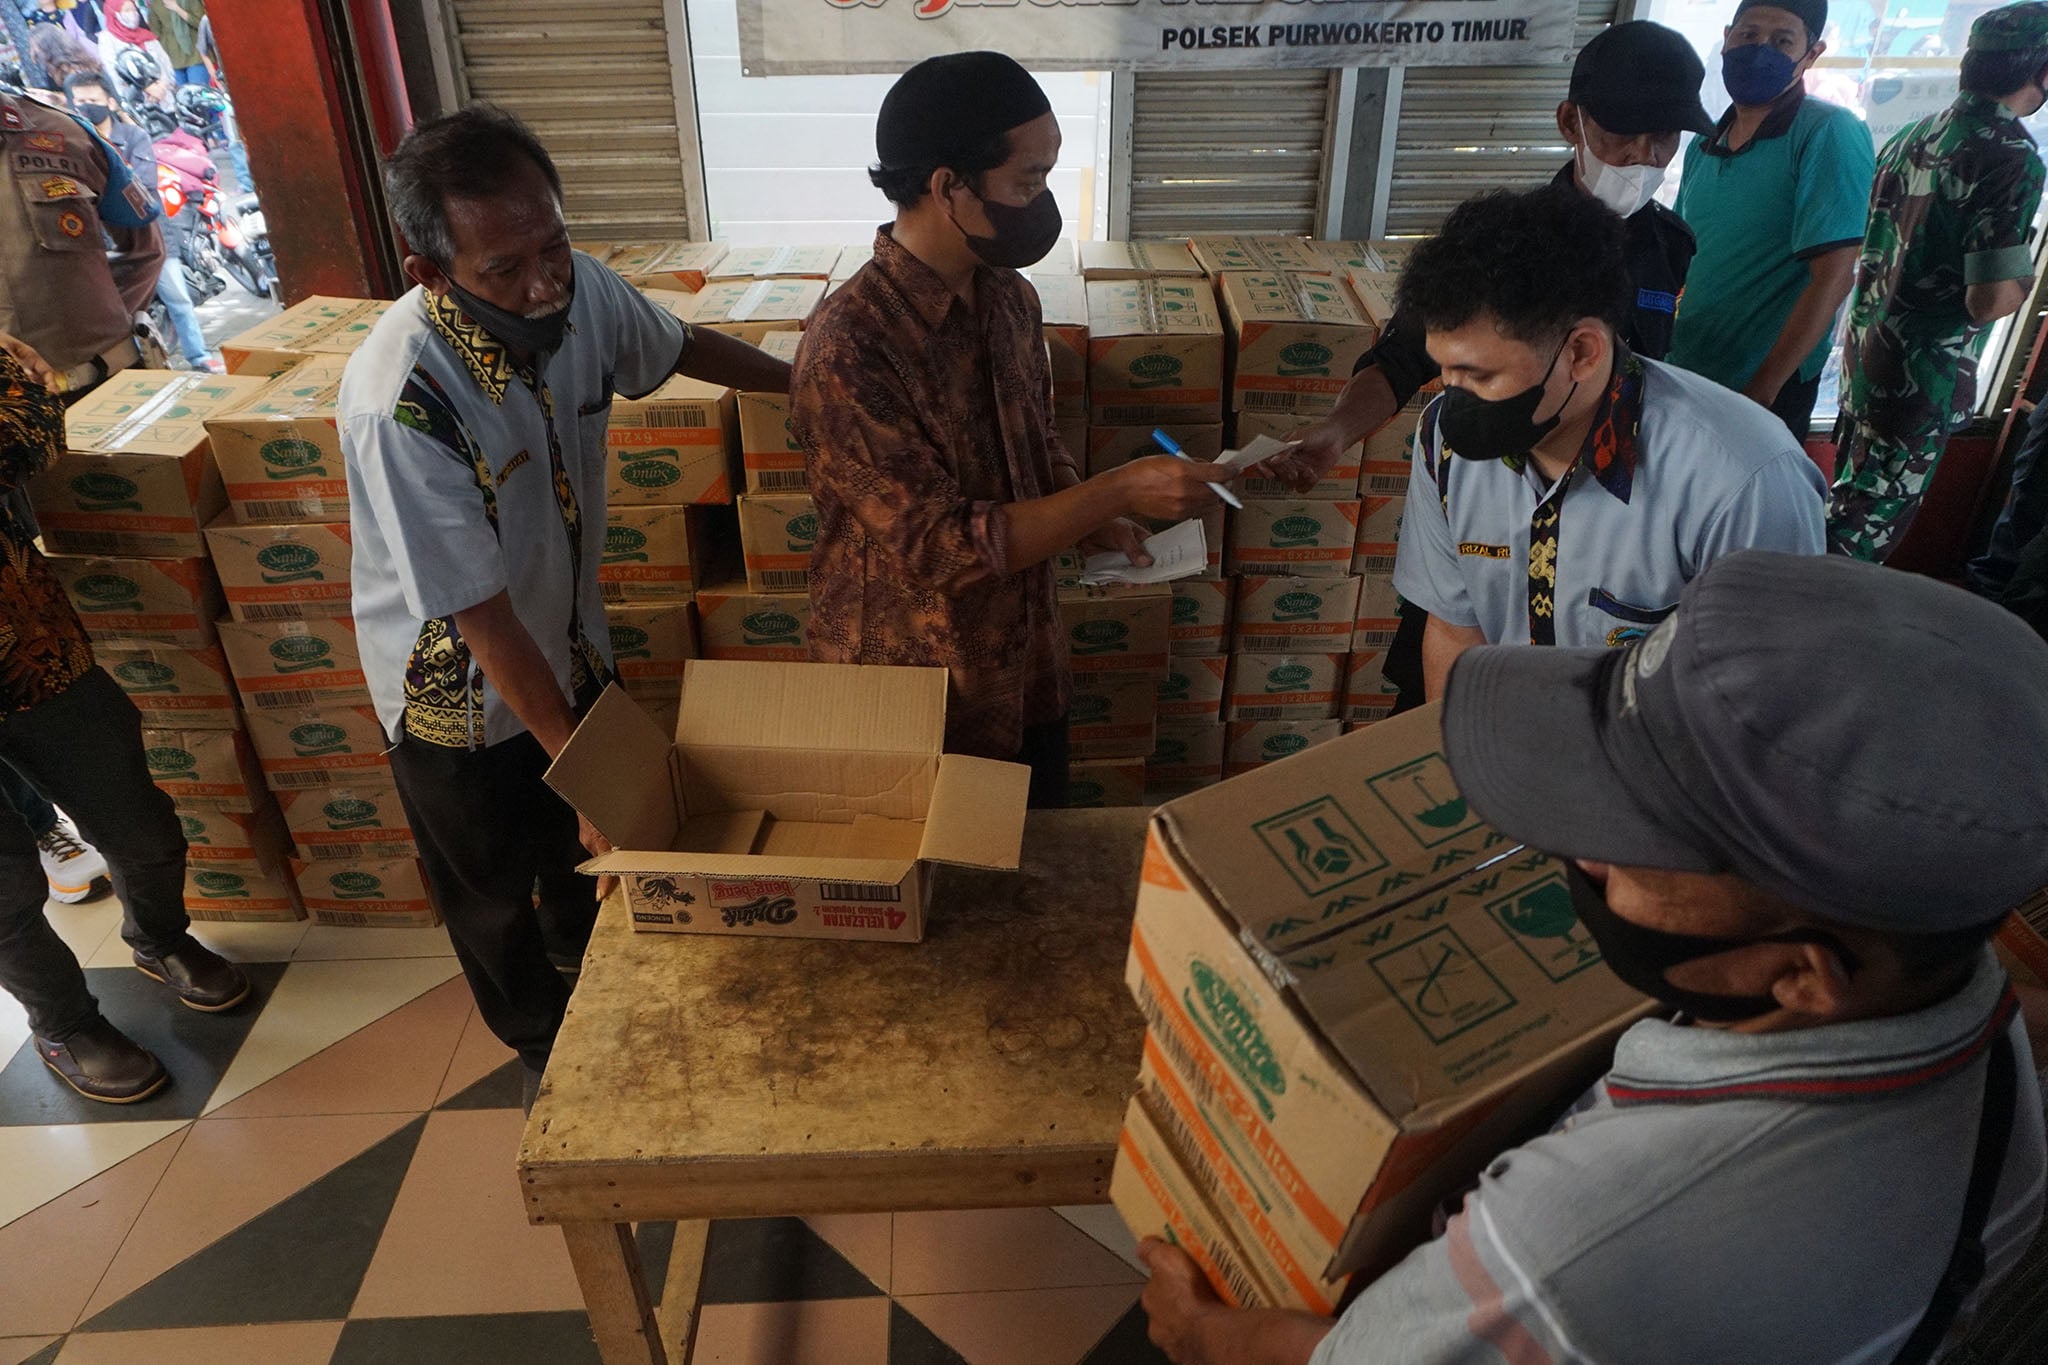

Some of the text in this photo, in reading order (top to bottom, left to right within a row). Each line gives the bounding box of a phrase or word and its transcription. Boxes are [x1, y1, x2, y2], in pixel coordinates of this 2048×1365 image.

[1162, 18, 1528, 50] POLSEK PURWOKERTO TIMUR
[19, 155, 80, 173] POLRI
[1290, 347, 1324, 361] Sania
[272, 444, 308, 458] Sania
[632, 465, 668, 481] Sania
[1283, 520, 1312, 533] Sania
[270, 548, 307, 564] Sania
[1461, 544, 1492, 556] RIZAL
[1283, 597, 1313, 608] Sania
[281, 642, 318, 656] Sania
[301, 728, 335, 741] Sania
[711, 880, 797, 901] beng-beng
[720, 896, 798, 928] Drink
[822, 913, 885, 929] KELEZATAN
[1206, 981, 1267, 1068] Sania
